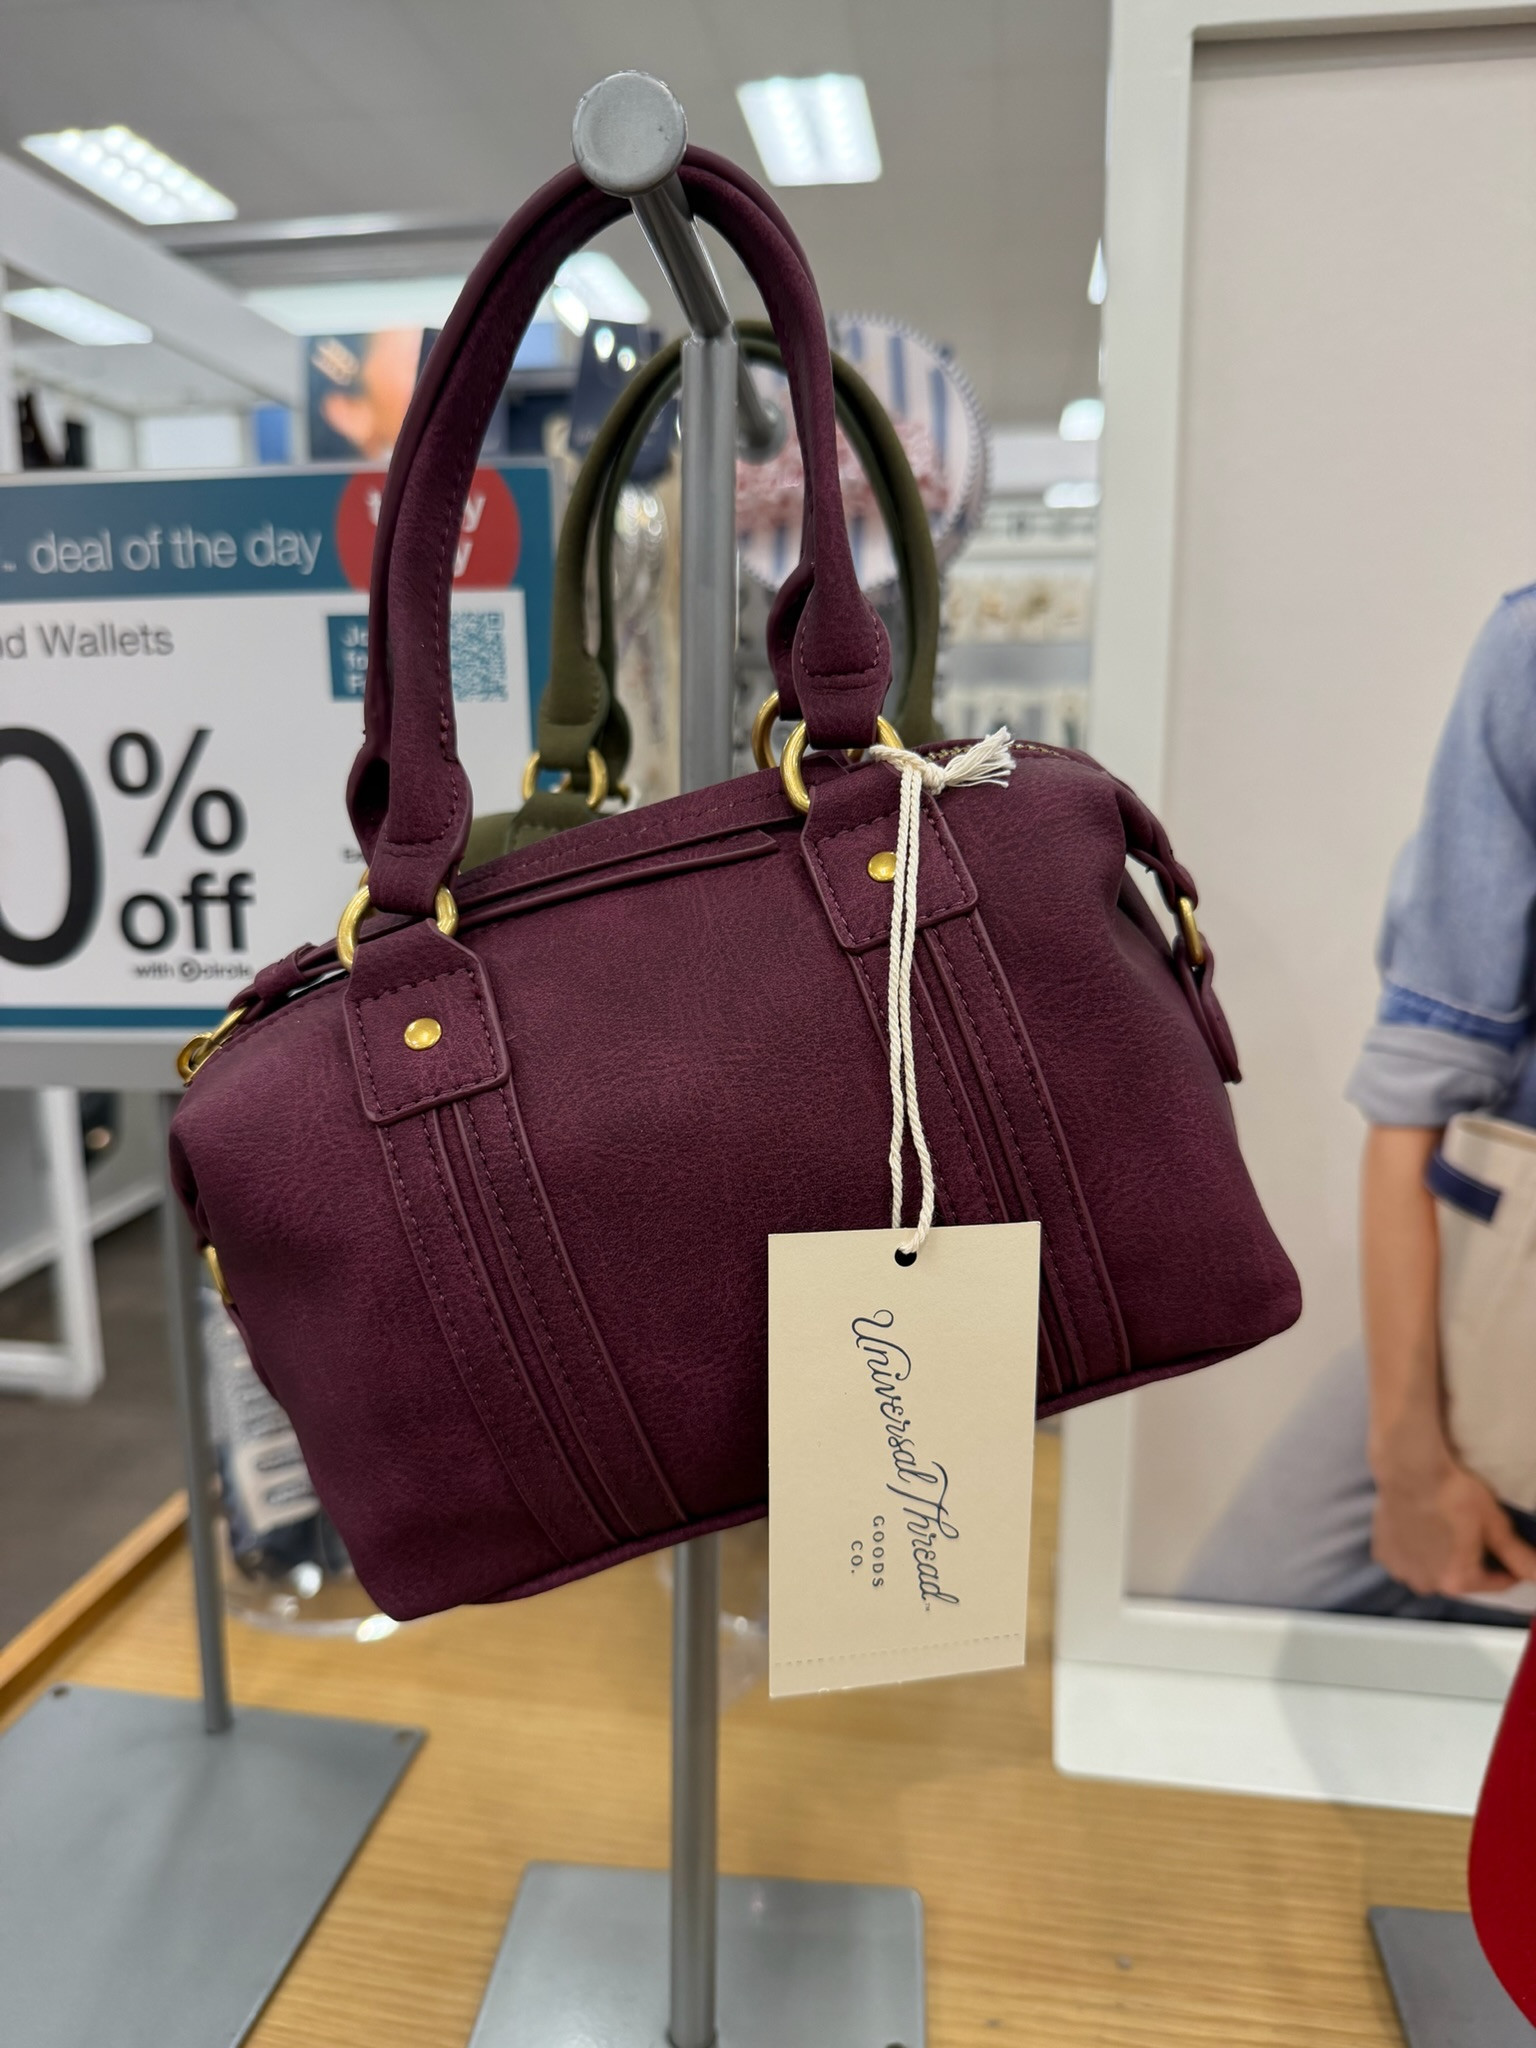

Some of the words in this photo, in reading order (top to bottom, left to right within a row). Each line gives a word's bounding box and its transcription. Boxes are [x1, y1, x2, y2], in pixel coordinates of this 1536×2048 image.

[28, 528, 113, 574] deal
[120, 522, 162, 571] of
[168, 522, 238, 569] the
[244, 519, 323, 575] day
[36, 620, 175, 659] Wallets
[118, 870, 256, 954] off
[851, 1308, 939, 1484] Universal
[850, 1539, 864, 1574] CO.
[871, 1514, 886, 1588] GOODS
[886, 1460, 960, 1605] Thread
